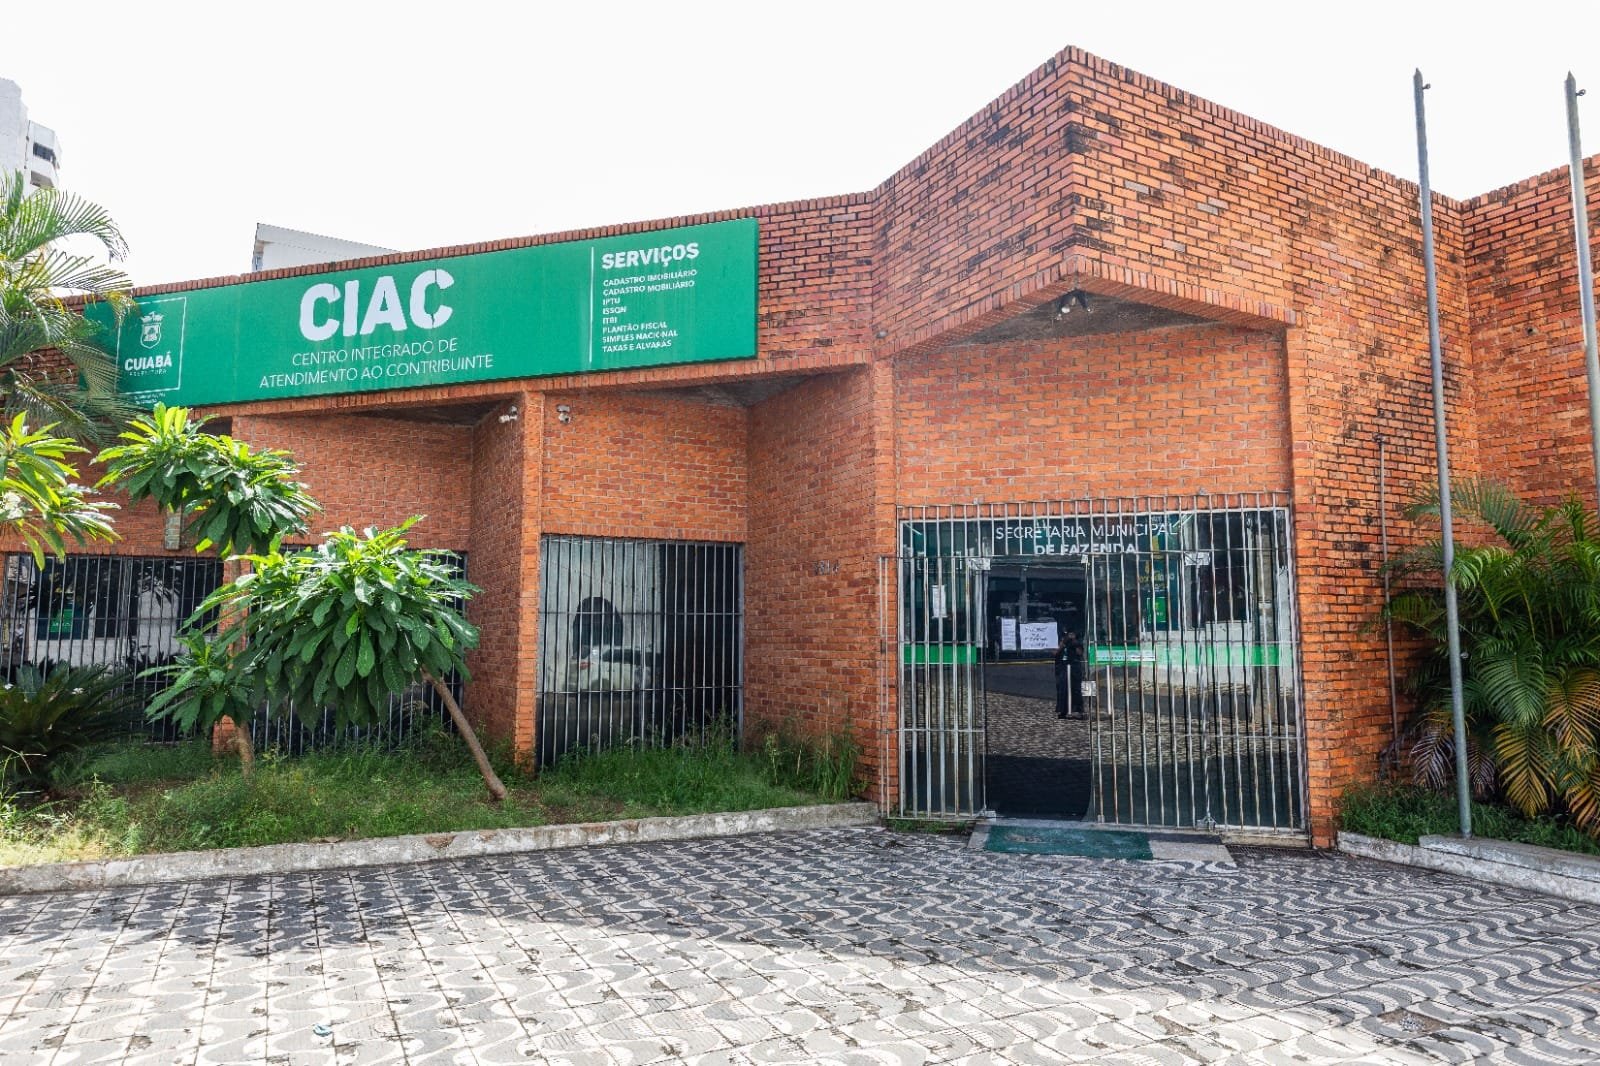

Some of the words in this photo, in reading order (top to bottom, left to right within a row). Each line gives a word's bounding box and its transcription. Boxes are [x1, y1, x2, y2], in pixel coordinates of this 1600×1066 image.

[602, 243, 699, 269] SERVIÇOS
[603, 275, 646, 287] CADASTRO
[603, 285, 646, 296] CADASTRO
[299, 268, 455, 341] CIAC
[602, 297, 621, 306] IPTU
[602, 316, 618, 325] ITBI
[602, 323, 639, 334] PLANTÃO
[640, 321, 668, 330] FISCAL
[602, 333, 635, 343] SIMPLES
[636, 330, 678, 340] NACIONAL
[292, 349, 348, 367] CENTRO
[351, 340, 434, 361] INTEGRADO
[438, 338, 458, 353] DE
[602, 343, 628, 353] TAXAS
[629, 343, 634, 351] E
[124, 351, 172, 371] CUIABÁ
[259, 367, 358, 389] ATENDIMENTO
[360, 365, 383, 380] AO
[386, 354, 494, 377] CONTRIBUINTE
[995, 524, 1086, 540] SECRETARIA
[1090, 522, 1178, 538] MUNICIPAL
[1035, 543, 1055, 555] DE
[1060, 543, 1137, 555] FAZENDA
